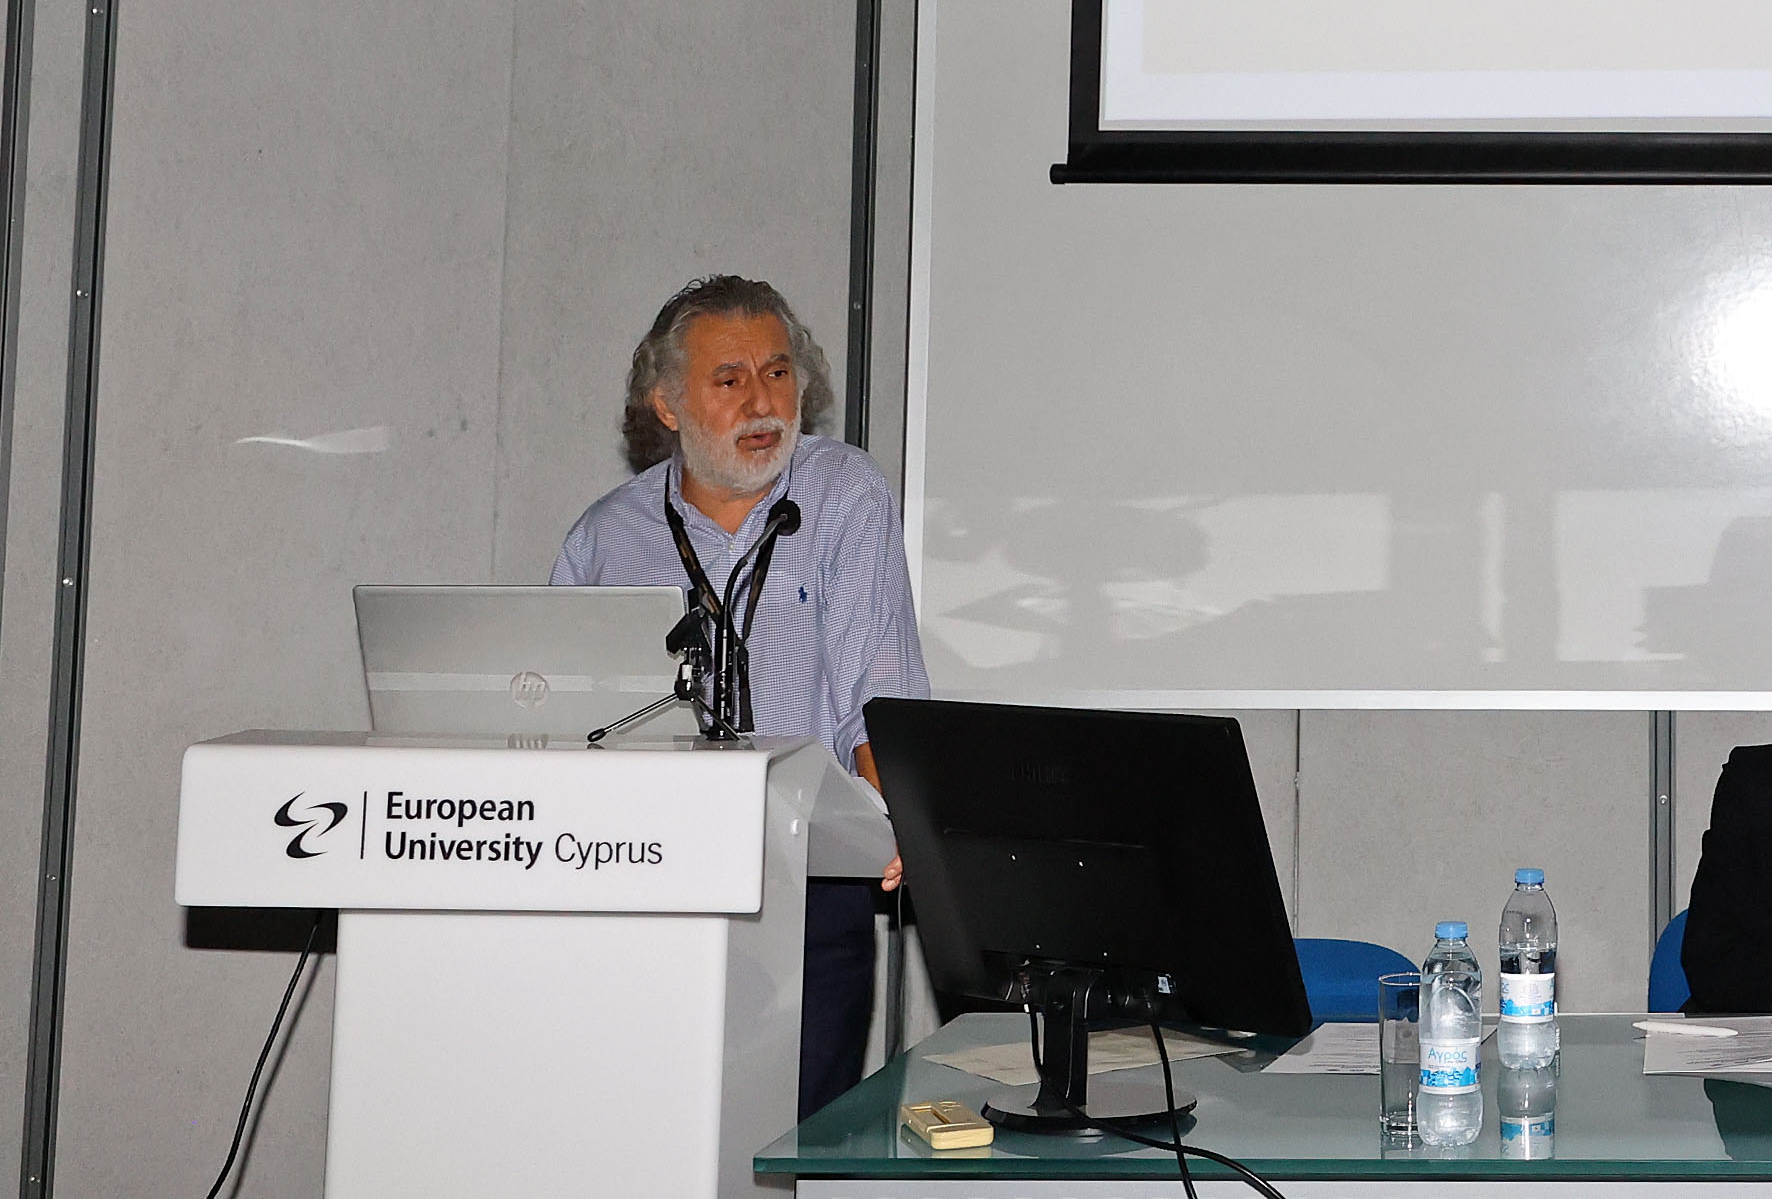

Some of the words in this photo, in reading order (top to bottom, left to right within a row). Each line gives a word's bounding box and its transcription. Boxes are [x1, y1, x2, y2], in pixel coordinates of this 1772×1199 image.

[386, 791, 535, 827] European
[385, 831, 543, 870] University
[555, 832, 663, 870] Cyprus
[1428, 1047, 1468, 1064] Αγρός
